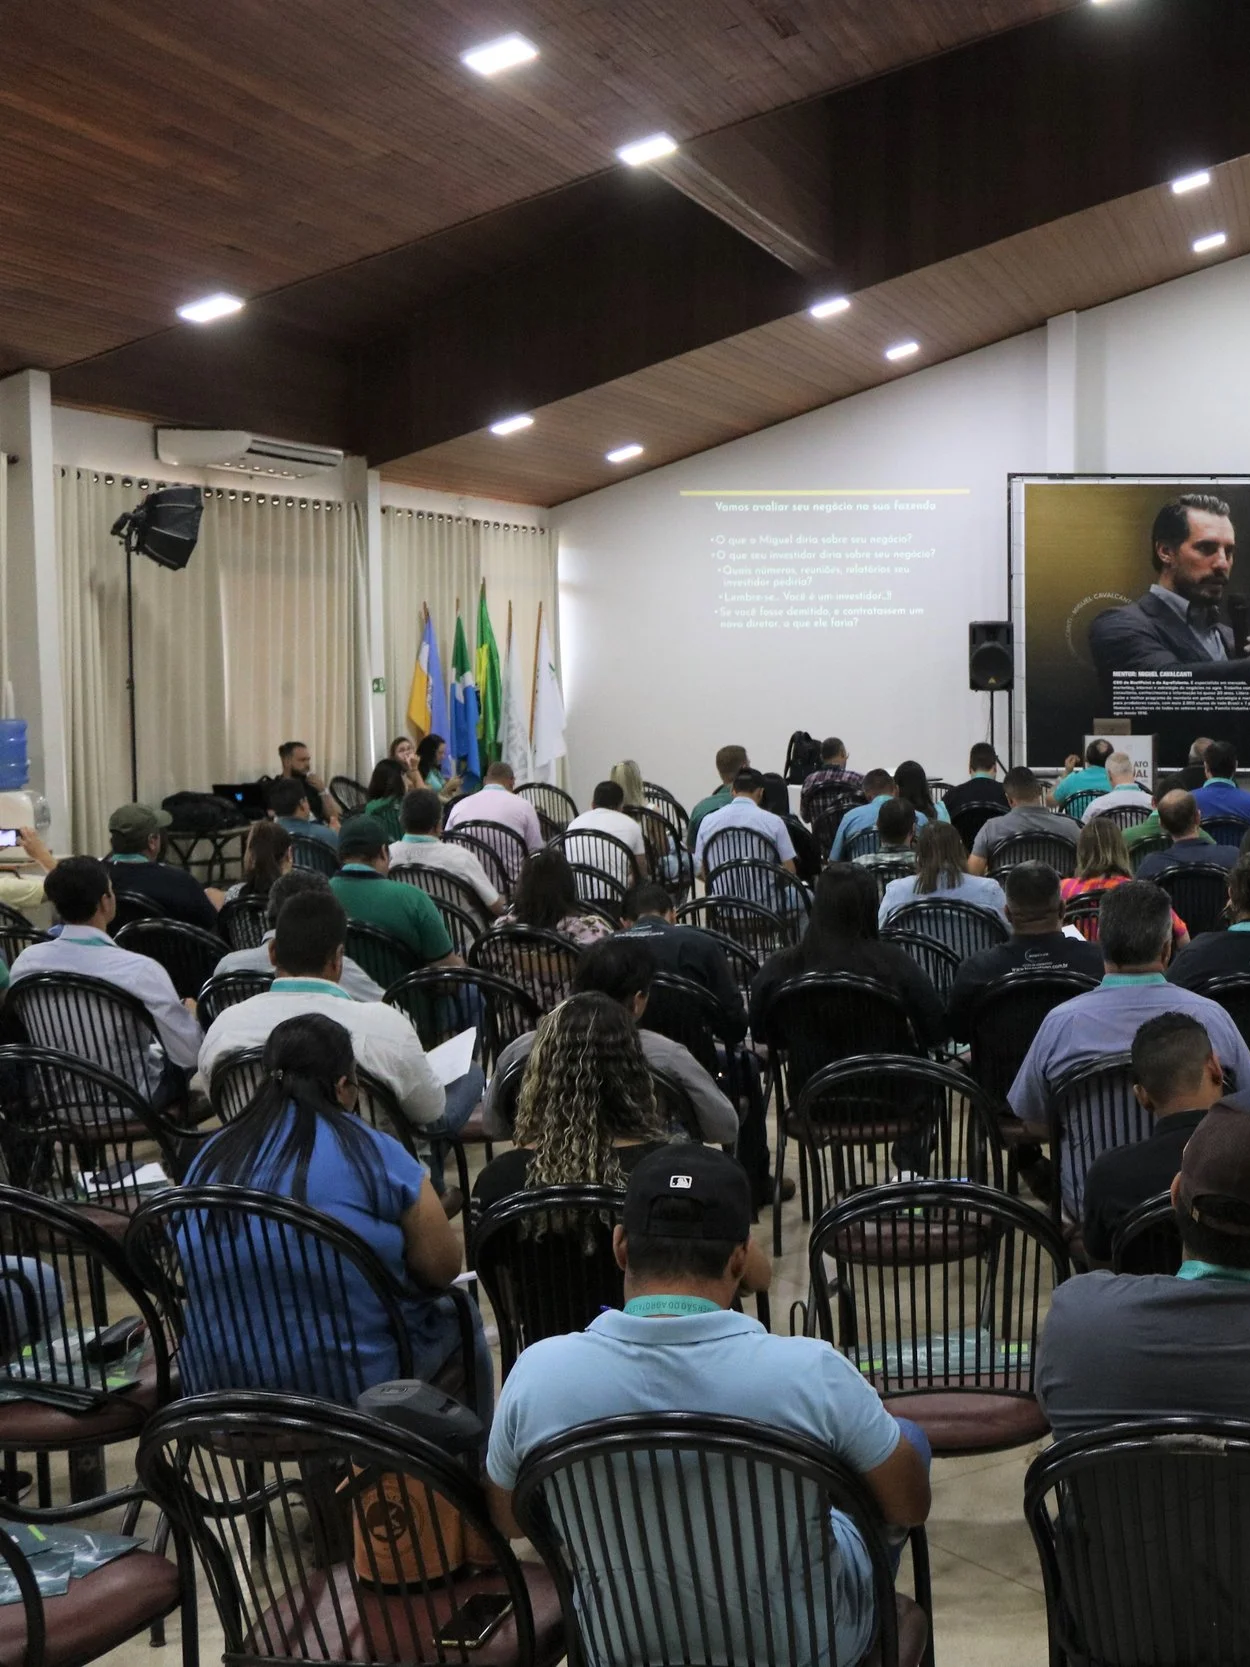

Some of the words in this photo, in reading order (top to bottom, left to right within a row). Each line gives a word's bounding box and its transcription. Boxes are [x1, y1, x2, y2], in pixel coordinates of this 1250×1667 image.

[715, 501, 749, 512] Vamos
[752, 501, 788, 512] avaliar
[894, 500, 936, 511] fazenda
[1094, 592, 1132, 604] CAVALCANT
